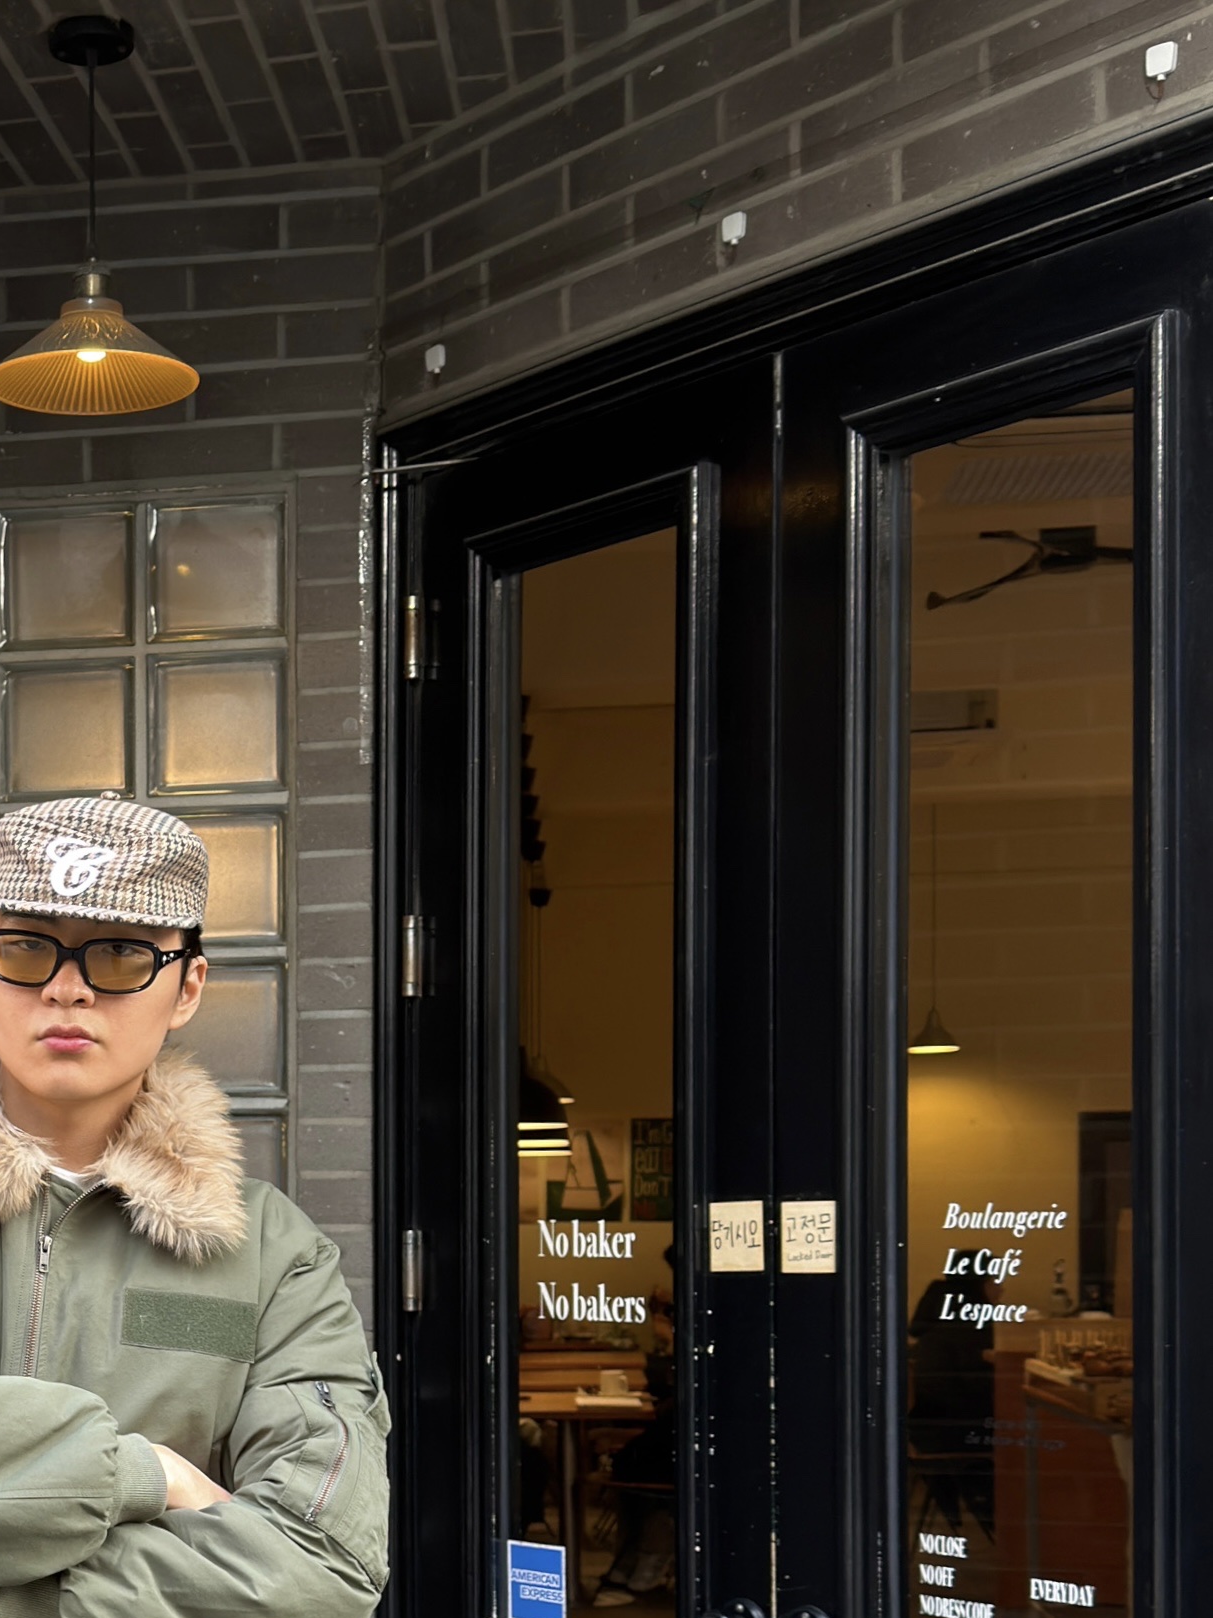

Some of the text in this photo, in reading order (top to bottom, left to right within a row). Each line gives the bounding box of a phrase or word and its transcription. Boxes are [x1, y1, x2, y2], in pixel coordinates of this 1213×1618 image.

[712, 1220, 761, 1250] 당기시오
[786, 1213, 834, 1243] 고정문
[942, 1202, 1067, 1238] Boulangerie
[537, 1219, 636, 1258] No baker
[942, 1248, 1022, 1284] Le Café
[537, 1282, 646, 1324] No bakers
[939, 1293, 1027, 1329] L'espace
[919, 1532, 967, 1558] NO CLOSE
[511, 1568, 559, 1588] AMERICAN
[919, 1563, 955, 1588] NO OFF
[521, 1586, 564, 1603] EXPRESS
[919, 1594, 934, 1615] NO
